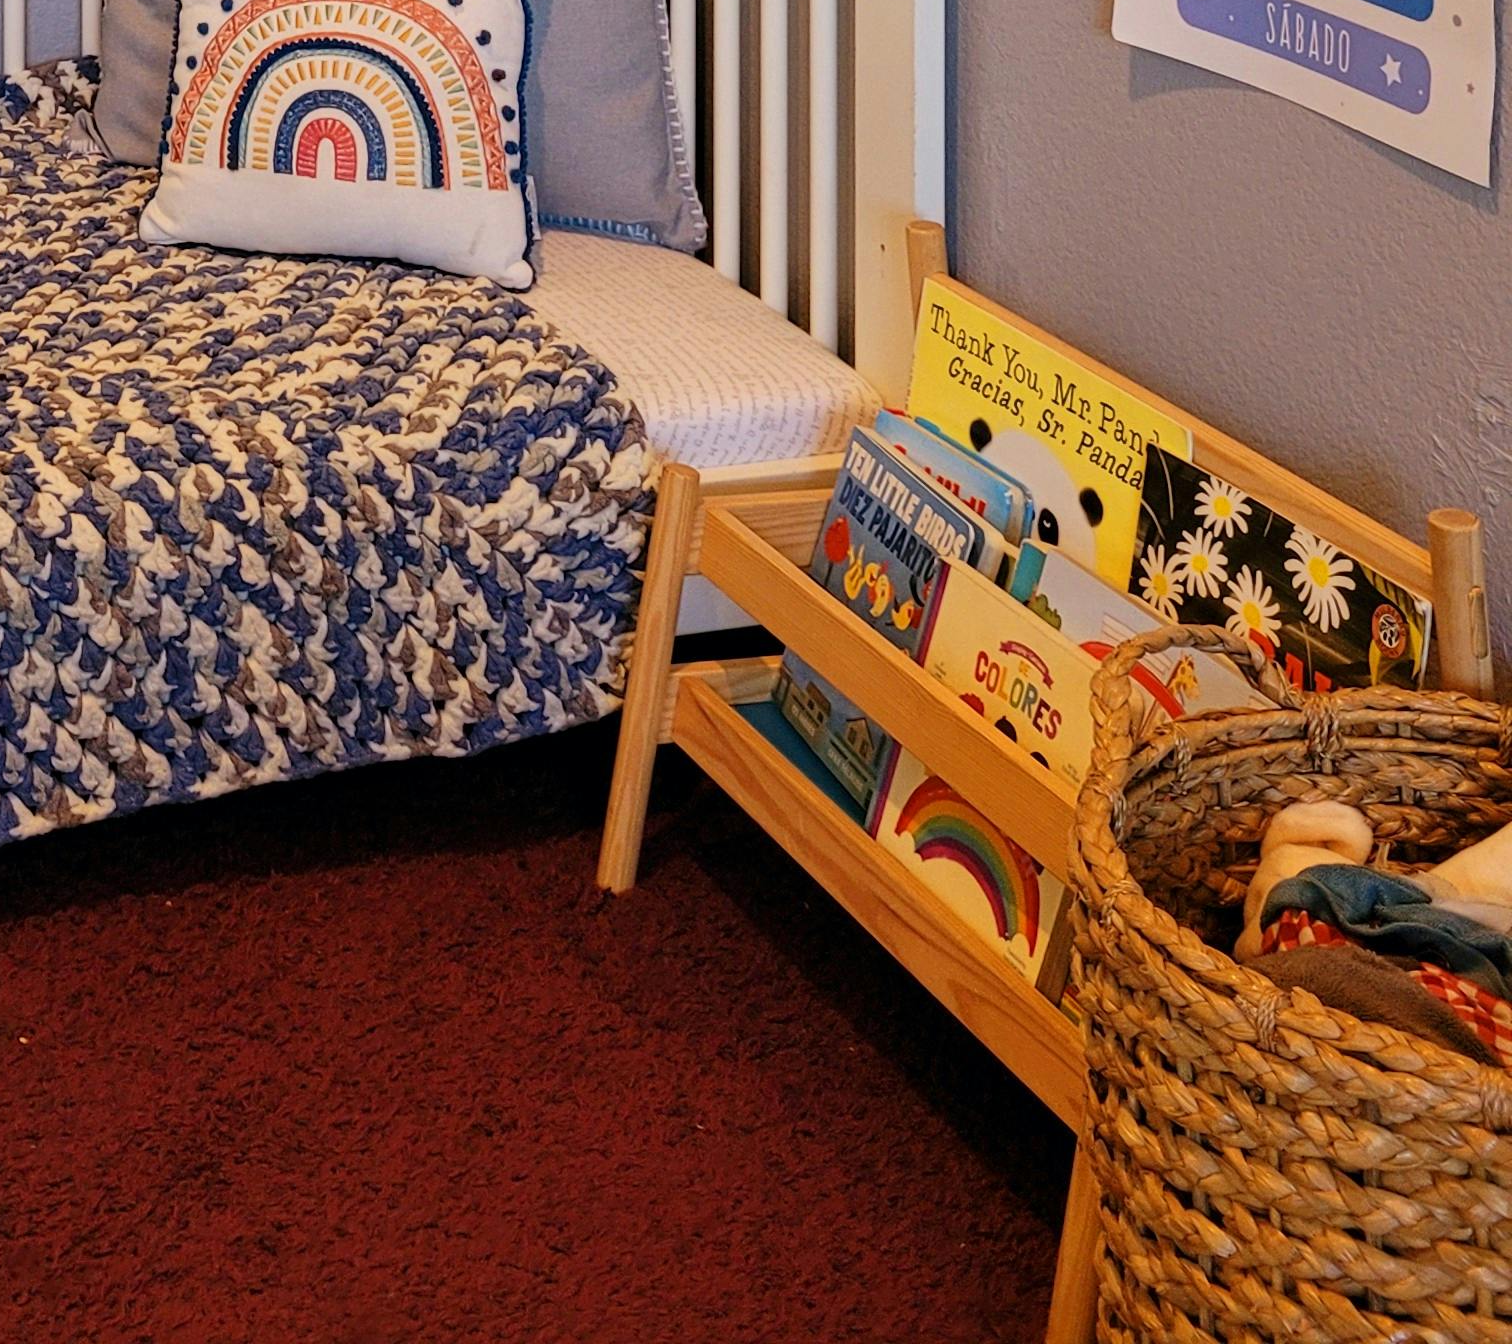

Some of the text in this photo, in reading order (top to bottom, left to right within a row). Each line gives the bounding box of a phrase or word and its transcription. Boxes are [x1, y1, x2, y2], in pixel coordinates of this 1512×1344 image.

[1266, 1, 1351, 73] SÁBADO
[930, 303, 996, 366] Thank
[1002, 343, 1044, 400] You,
[1051, 373, 1092, 424] Mr.
[948, 356, 1144, 491] Gracias, Sr. Panda
[839, 476, 874, 525] DIEZ
[845, 439, 876, 486] TEN
[869, 464, 921, 526] LITTLE
[913, 503, 967, 561] BIRDS
[974, 650, 1063, 741] COLORES
